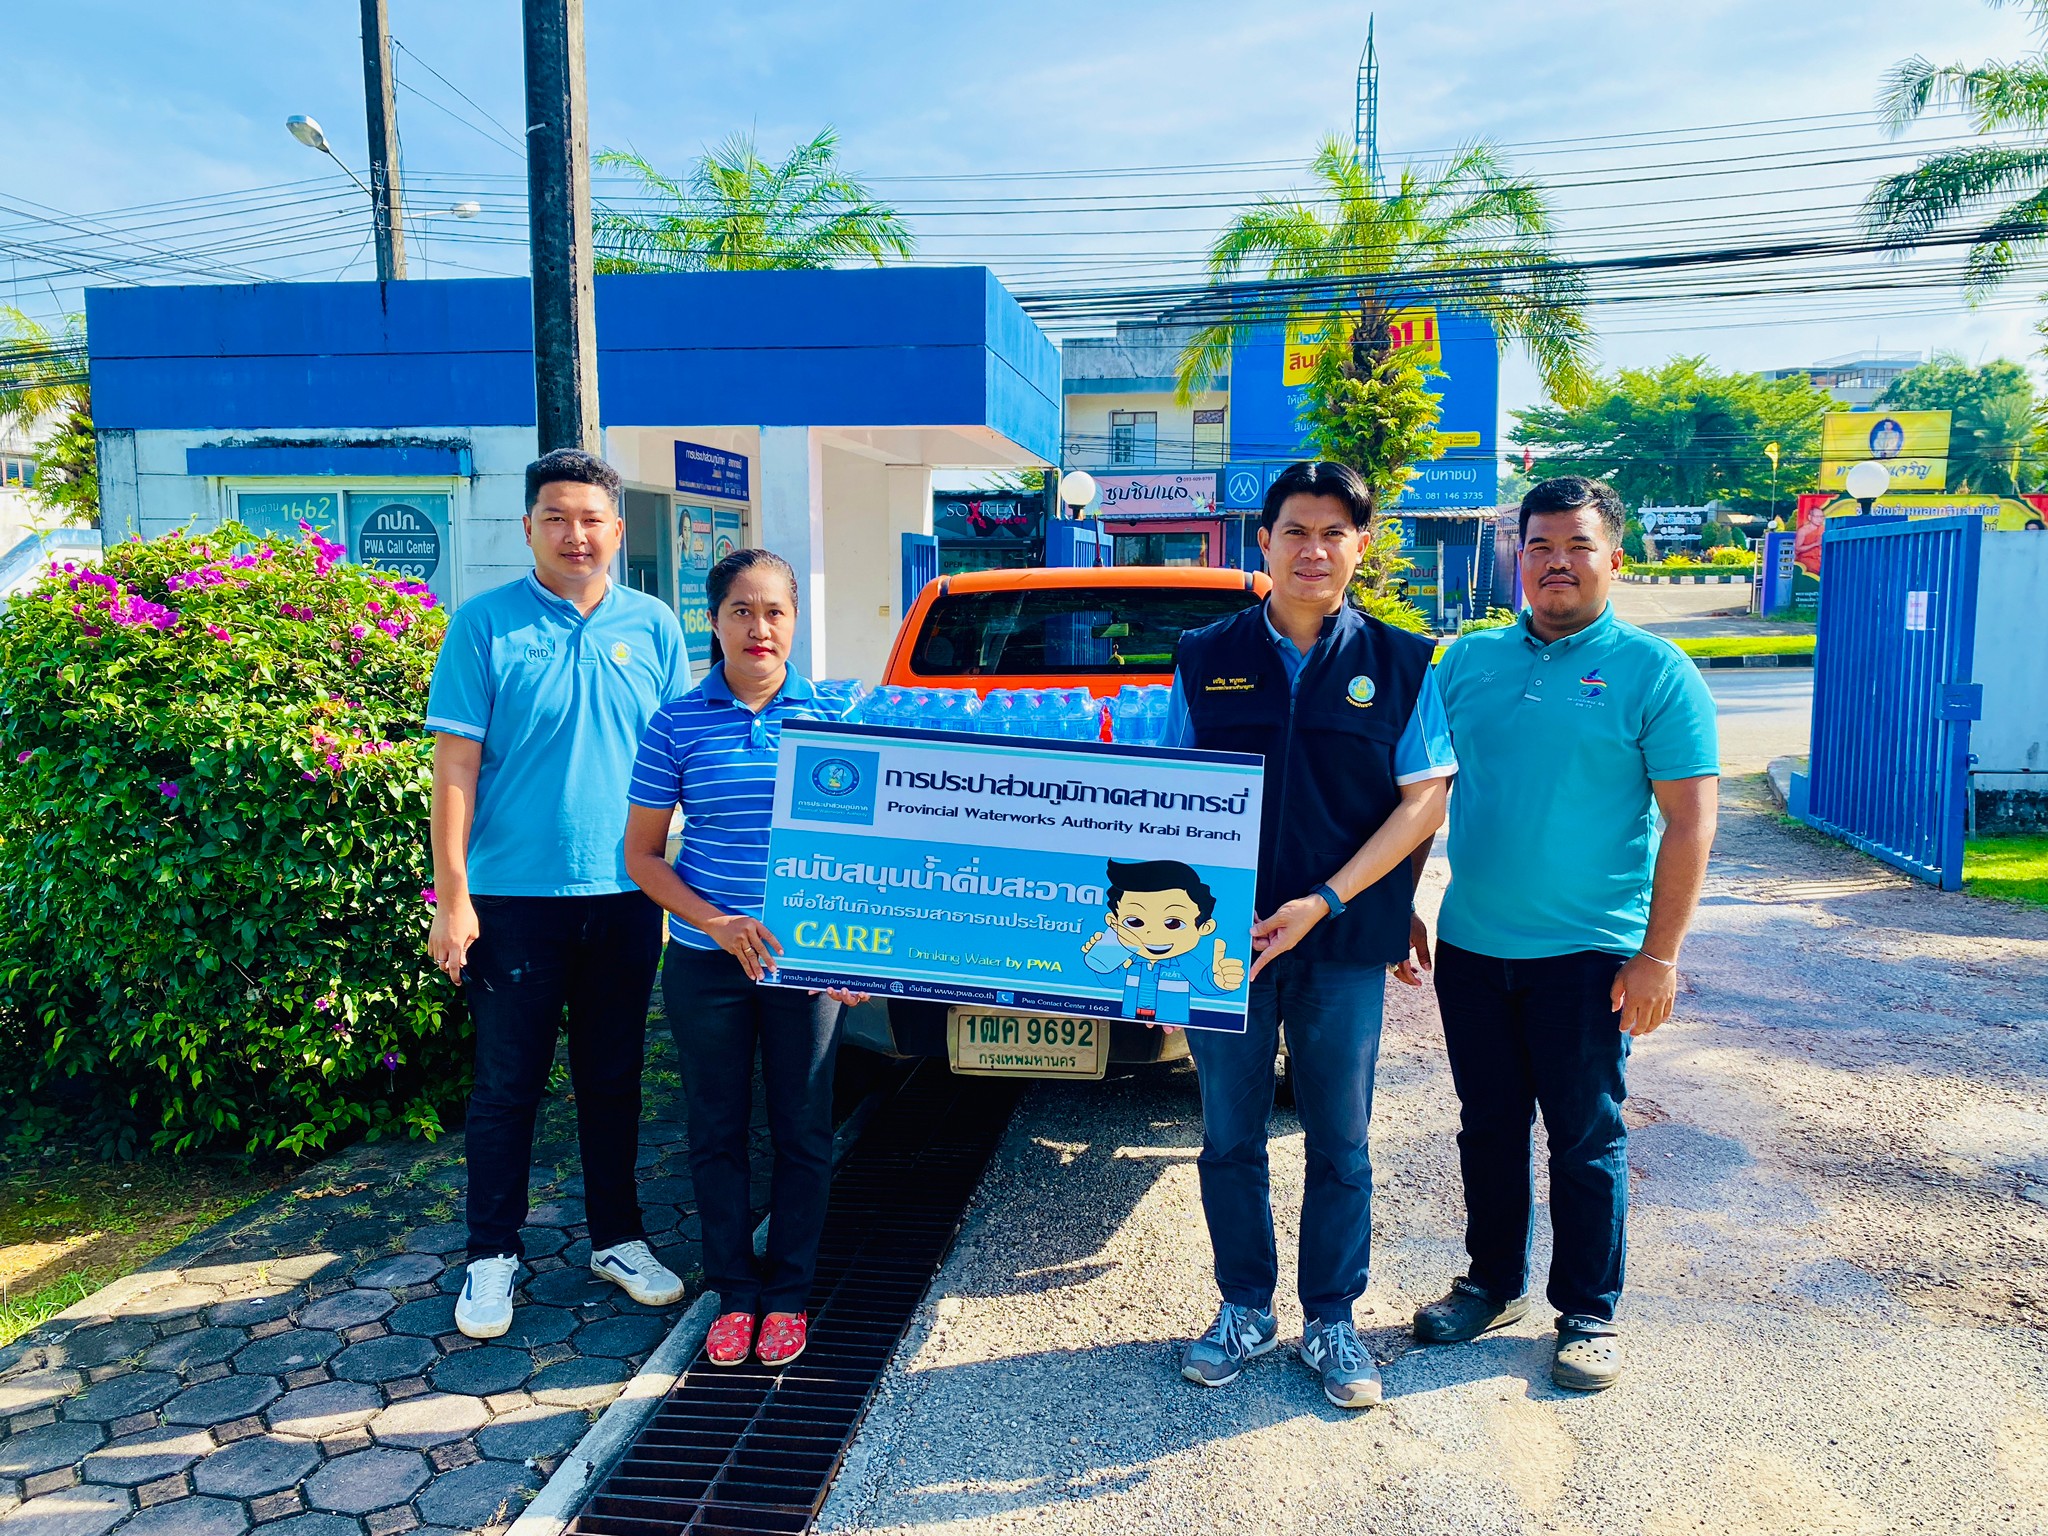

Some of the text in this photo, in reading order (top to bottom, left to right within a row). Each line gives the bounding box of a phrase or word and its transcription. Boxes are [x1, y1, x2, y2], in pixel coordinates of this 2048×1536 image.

[1425, 468, 1477, 483] (มหาชน)
[281, 497, 331, 521] 1662
[364, 540, 435, 554] PWA Call Center
[529, 649, 549, 659] RID
[884, 768, 1249, 815] การประปาส่วนภูมิภาคสาขากระบี่
[887, 801, 1241, 842] Provincial Waterworks Authority Krabi Branch
[773, 853, 1104, 906] สนับสนุนน้ำดื่มสะอาด
[782, 889, 1083, 935] เพื่อใช้ในกิจกรรมสาธารณประโยชน์
[794, 920, 895, 956] CARE
[908, 947, 1062, 973] Drinking Water by PWA
[934, 988, 994, 1000] www.pwa.co.th
[1021, 997, 1110, 1012] Pwa Contact Center 1662
[1027, 1018, 1094, 1047] 9692
[979, 1053, 1077, 1069] กรุงเทพมหานคร
